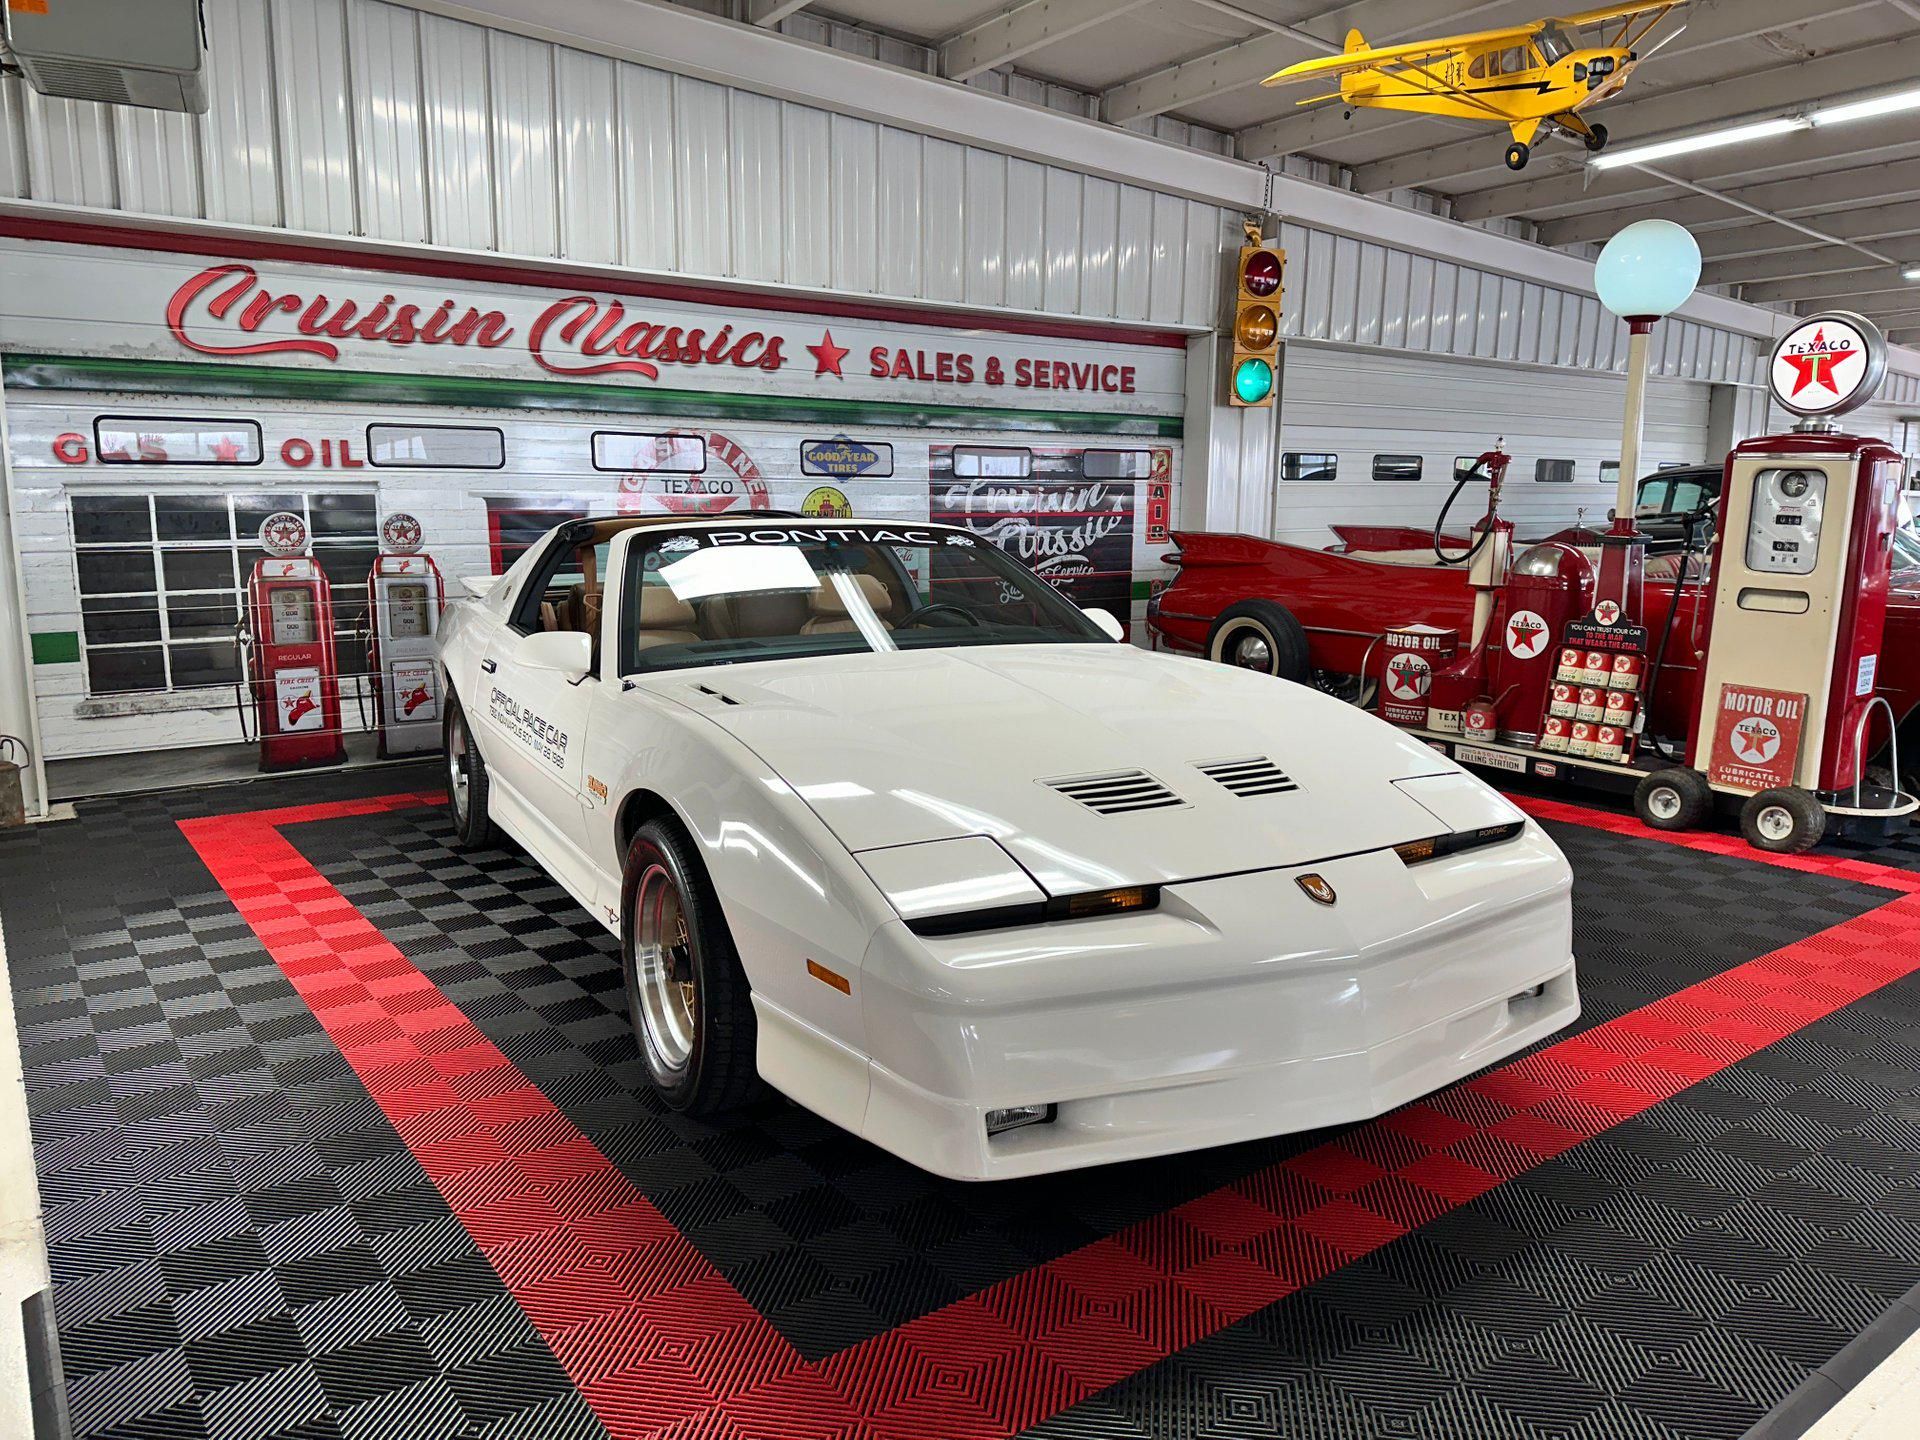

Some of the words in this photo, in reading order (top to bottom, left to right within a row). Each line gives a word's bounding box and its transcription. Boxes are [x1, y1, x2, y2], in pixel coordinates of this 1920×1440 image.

[166, 263, 515, 361] Cruisin
[528, 295, 788, 381] Classics
[1789, 339, 1851, 355] TEXACO
[869, 346, 975, 384] SALES
[984, 355, 1005, 386] &
[1014, 357, 1137, 394] SERVICE
[281, 437, 364, 468] OIL
[828, 463, 858, 473] TIRES
[660, 479, 734, 494] TEXACO
[1151, 485, 1167, 539] AIR
[707, 529, 938, 546] PONTIAC
[1512, 619, 1542, 629] TEXACO
[1571, 623, 1583, 631] YOU
[1596, 626, 1613, 634] TRUST
[1386, 633, 1420, 650] MOTOR
[1422, 636, 1441, 650] OIL
[1569, 637, 1584, 645] THAT
[1585, 639, 1608, 647] WEARS
[278, 653, 312, 661] REGULAR
[1391, 660, 1429, 672] TEXACO
[1384, 706, 1426, 717] LUBRICATES
[1724, 692, 1773, 716] MOTOR
[1776, 699, 1799, 720] OIL
[1385, 712, 1424, 721] PERFECTLY
[522, 708, 547, 740] PACE
[545, 724, 568, 754] CAR
[1738, 724, 1777, 736] TEXACO
[1460, 752, 1488, 765] FILLING
[1488, 757, 1520, 770] STATION
[1472, 750, 1509, 761] GASOLINE
[1536, 765, 1555, 774] TEXACO
[1719, 765, 1781, 783] LUBRICATES
[1720, 774, 1777, 789] PERFECTLY
[1479, 825, 1509, 837] PONTIAC
